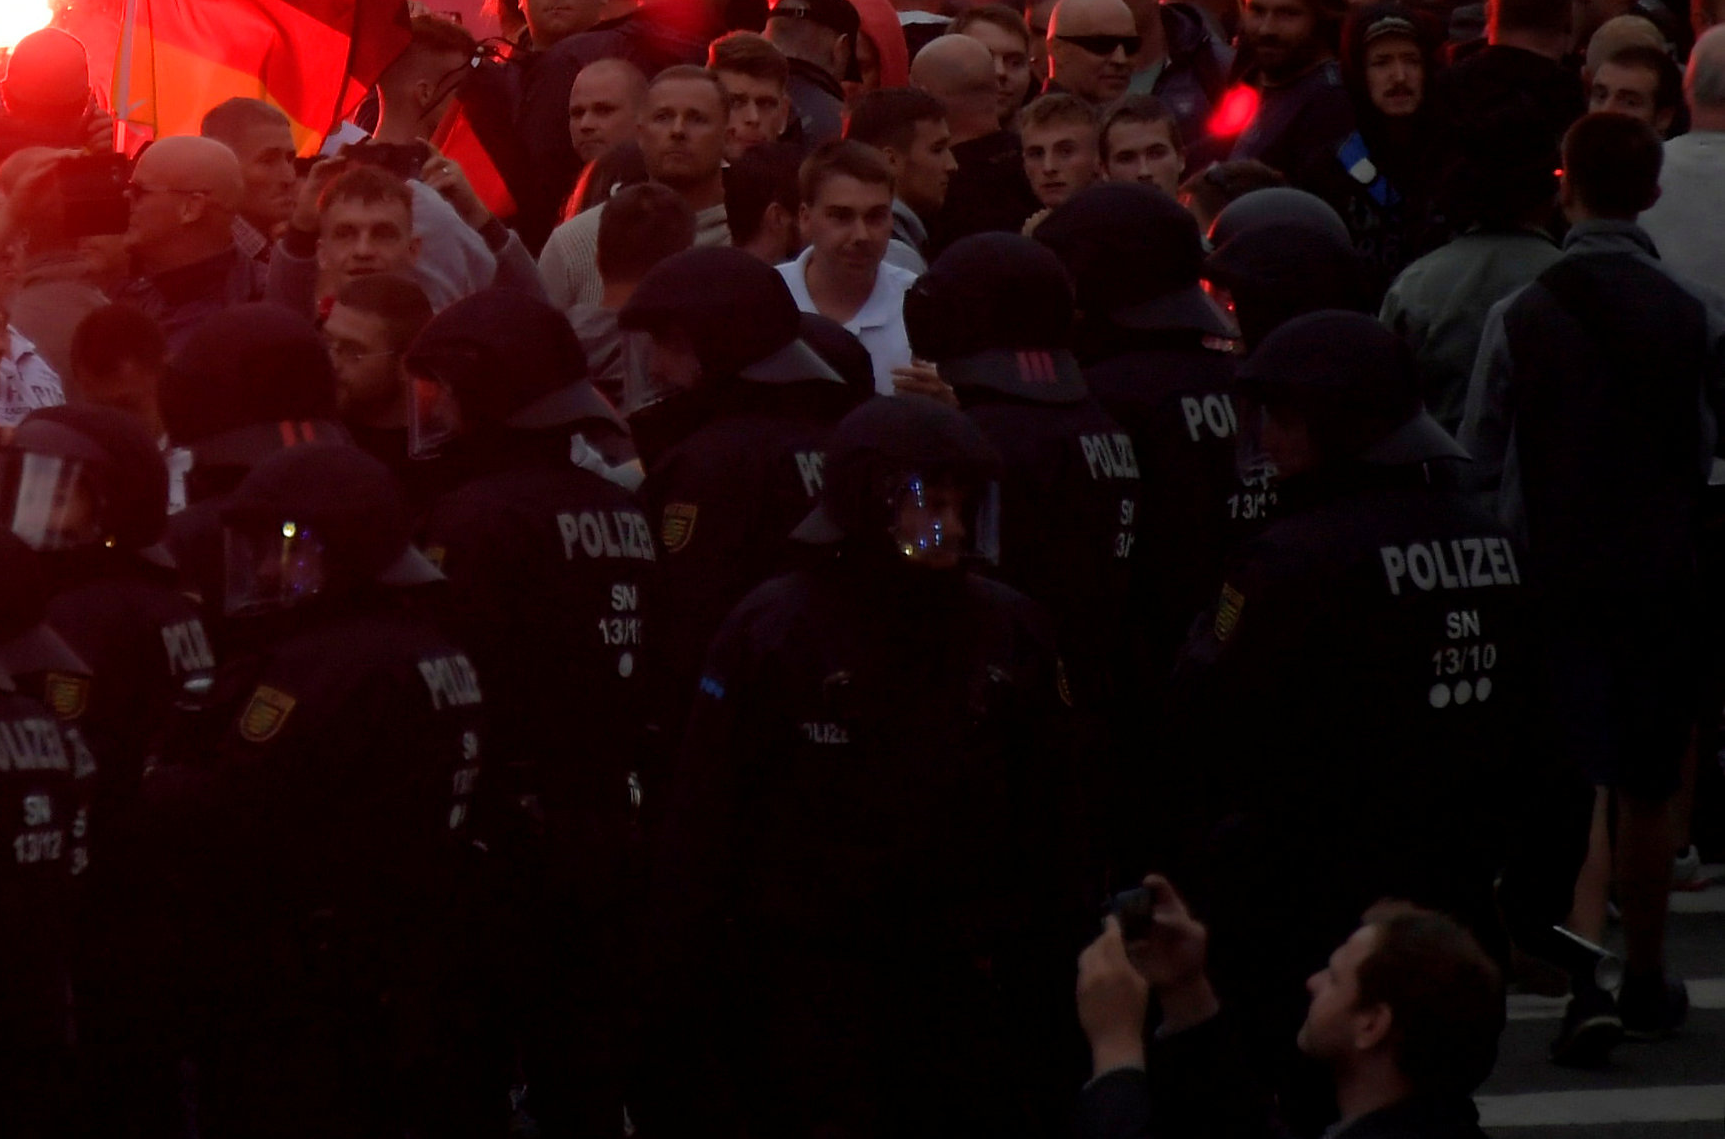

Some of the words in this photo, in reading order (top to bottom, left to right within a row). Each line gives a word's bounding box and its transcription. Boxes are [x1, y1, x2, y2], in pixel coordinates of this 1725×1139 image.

[1379, 536, 1521, 596] POLIZEI
[610, 582, 638, 612] SN
[1445, 609, 1482, 640] SN
[1431, 642, 1498, 677] 13/10
